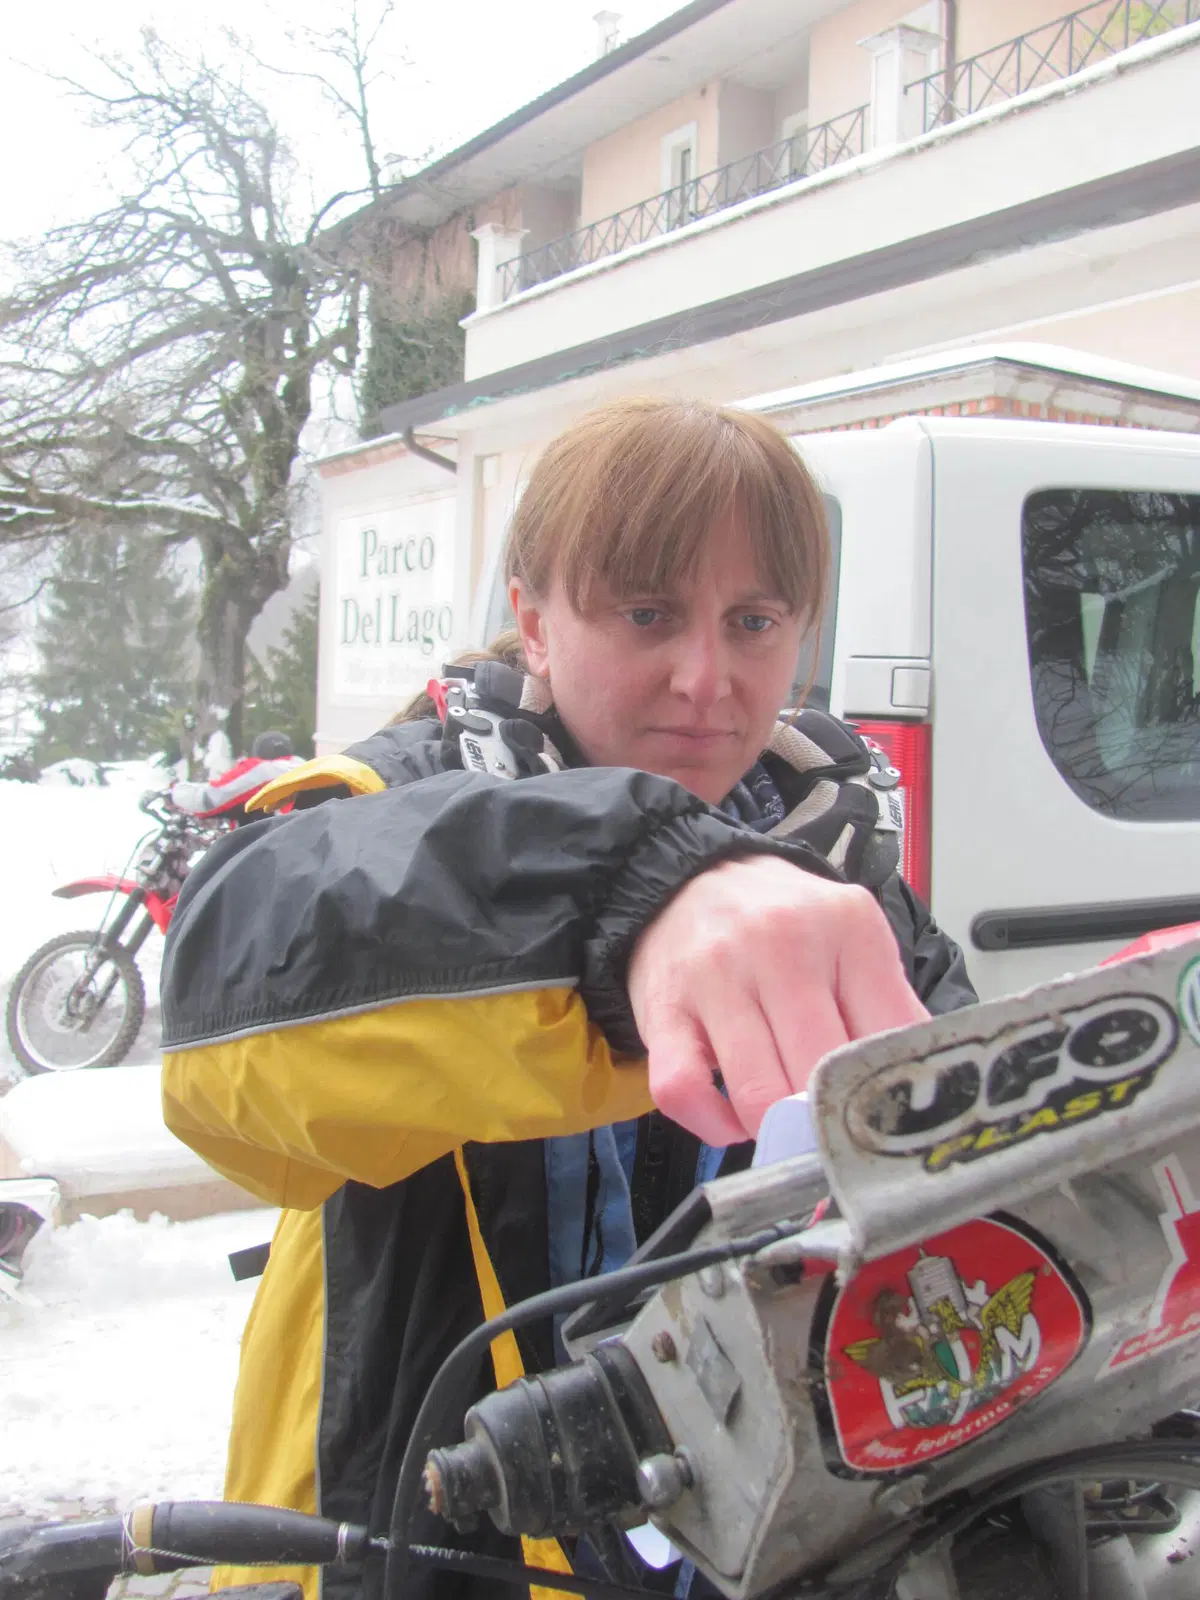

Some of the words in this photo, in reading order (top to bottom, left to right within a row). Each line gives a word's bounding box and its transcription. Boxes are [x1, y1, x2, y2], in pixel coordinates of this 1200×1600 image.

[360, 528, 435, 577] Parco
[341, 597, 381, 645] Del
[389, 595, 453, 656] Lago
[858, 1000, 1168, 1142] UFO
[927, 1076, 1141, 1167] PLAST
